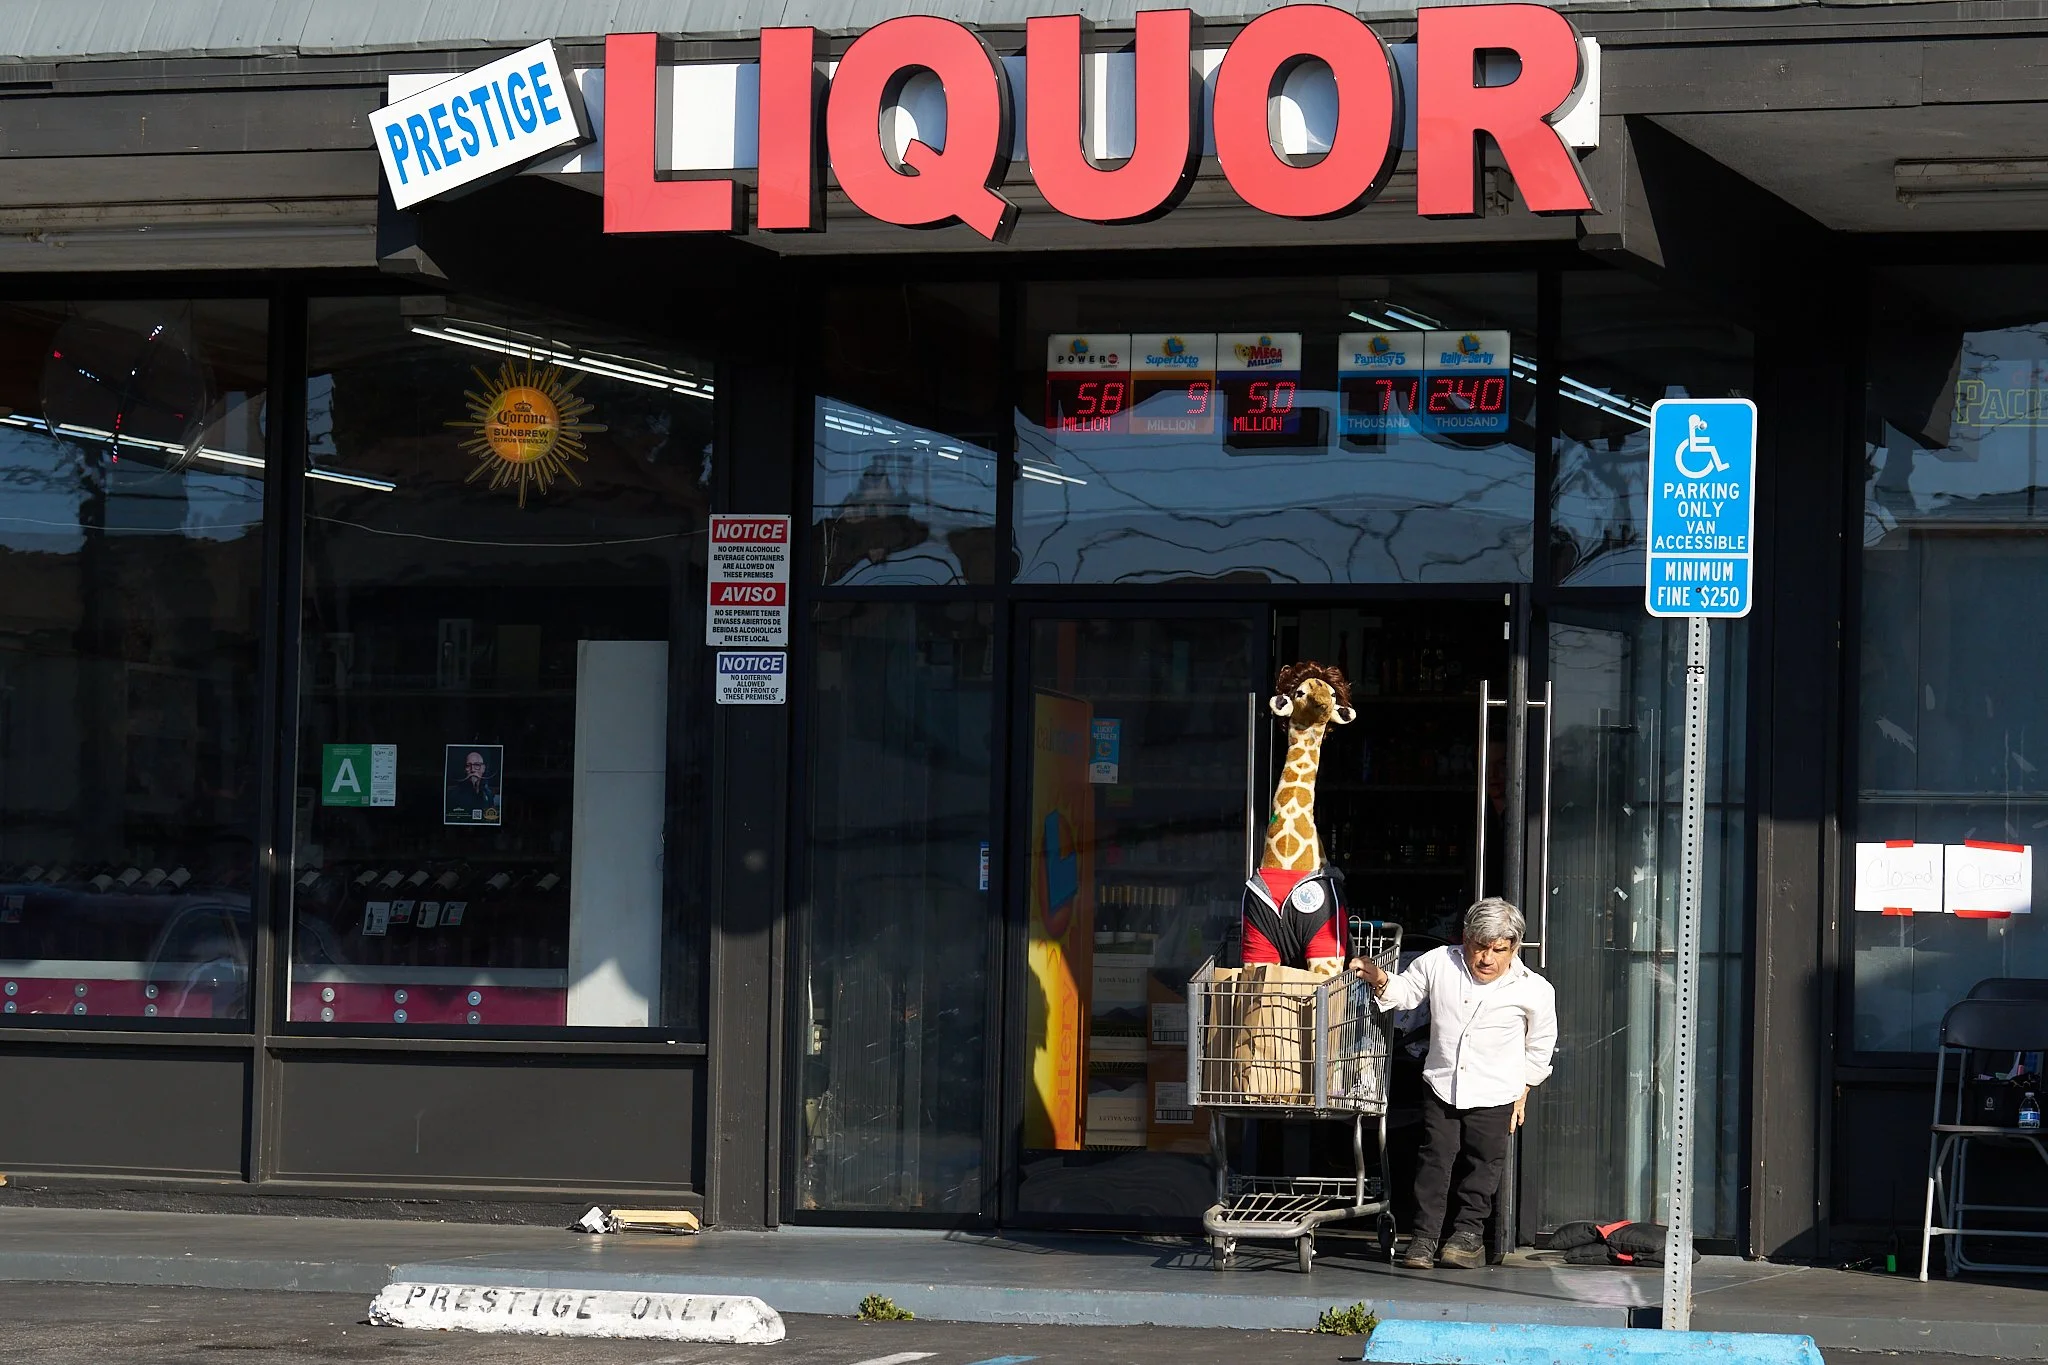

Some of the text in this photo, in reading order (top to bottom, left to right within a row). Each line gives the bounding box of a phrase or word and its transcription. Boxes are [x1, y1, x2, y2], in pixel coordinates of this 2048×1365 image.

[386, 61, 562, 185] PRESTIGE
[603, 3, 1595, 241] LIQUOR
[1057, 355, 1106, 364] POWER
[1250, 346, 1283, 358] MEGA
[1354, 353, 1395, 366] Fantasy
[1440, 352, 1494, 365] Daily Derby
[1145, 354, 1199, 367] SuperLotto
[1077, 382, 1124, 415] 58
[1187, 382, 1209, 414] 9
[1248, 382, 1295, 414] 50
[1376, 379, 1418, 411] 71
[1428, 379, 1504, 411] 240
[496, 409, 547, 427] Corona
[1062, 416, 1111, 431] MILLION
[1147, 419, 1196, 431] MILLION
[1233, 416, 1283, 431] MILLION
[1347, 417, 1410, 429] THOUSAND
[1435, 416, 1498, 428] THOUSAND
[493, 428, 550, 438] SUNBREW
[1663, 482, 1740, 500] PARKING
[1677, 501, 1724, 518] ONLY
[715, 523, 784, 539] NOTICE
[1686, 520, 1716, 535] VAN
[1654, 535, 1746, 550] ACCESSIBLE
[1665, 561, 1733, 582] MINIMUM
[720, 586, 777, 602] AVISO
[1657, 585, 1740, 609] FINE $250
[721, 657, 782, 671] NOTICE
[331, 758, 361, 793] A
[1866, 858, 1933, 888] Closed
[1957, 862, 2022, 889] Closed
[404, 1285, 727, 1321] PRESTIGE ONLY
